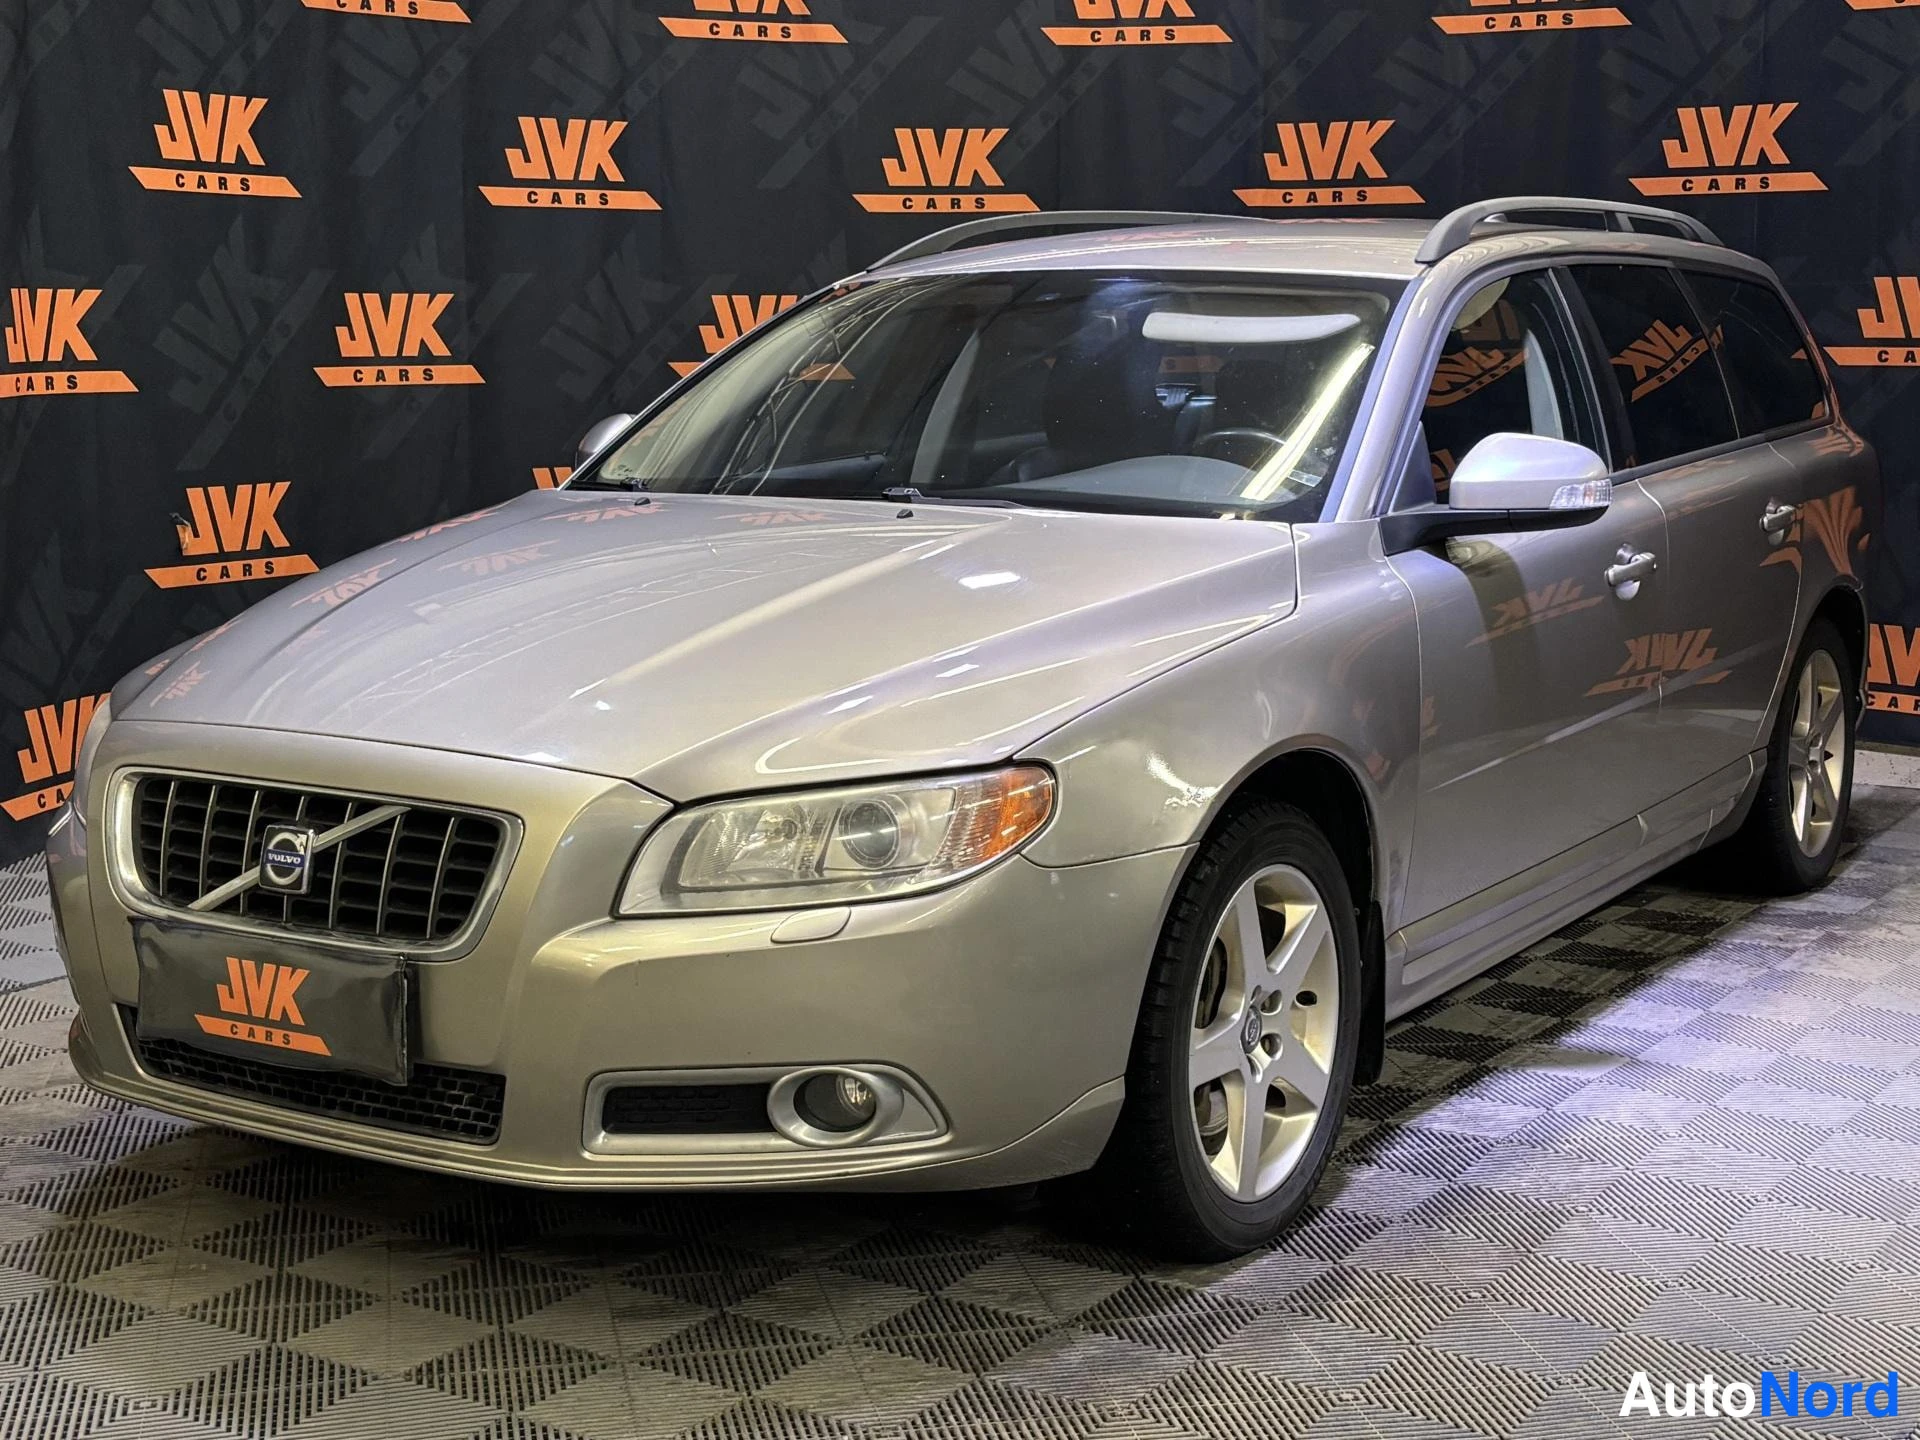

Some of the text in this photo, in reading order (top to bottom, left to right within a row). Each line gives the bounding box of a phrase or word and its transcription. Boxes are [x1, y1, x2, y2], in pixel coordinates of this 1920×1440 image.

[708, 22, 792, 39] CARS
[1484, 13, 1574, 30] CARS
[1090, 29, 1176, 43] CARS
[154, 89, 269, 166] JVK
[1661, 102, 1799, 168] JVK
[504, 116, 629, 182] JVK
[881, 128, 1010, 187] JVK
[1263, 119, 1396, 181] JVK
[175, 173, 251, 192] CARS
[1681, 177, 1770, 192] CARS
[526, 191, 610, 206] CARS
[902, 197, 986, 210] CARS
[1281, 190, 1368, 204] CARS
[5, 288, 103, 363] JVK
[335, 292, 455, 357] JVK
[698, 294, 798, 354] JV
[15, 374, 78, 392] CARS
[352, 368, 434, 383] CARS
[175, 481, 291, 556] JVK
[196, 561, 275, 582] CARS
[267, 852, 302, 865] VOLVO
[216, 956, 310, 1026] JVK
[230, 1023, 291, 1045] CARS
